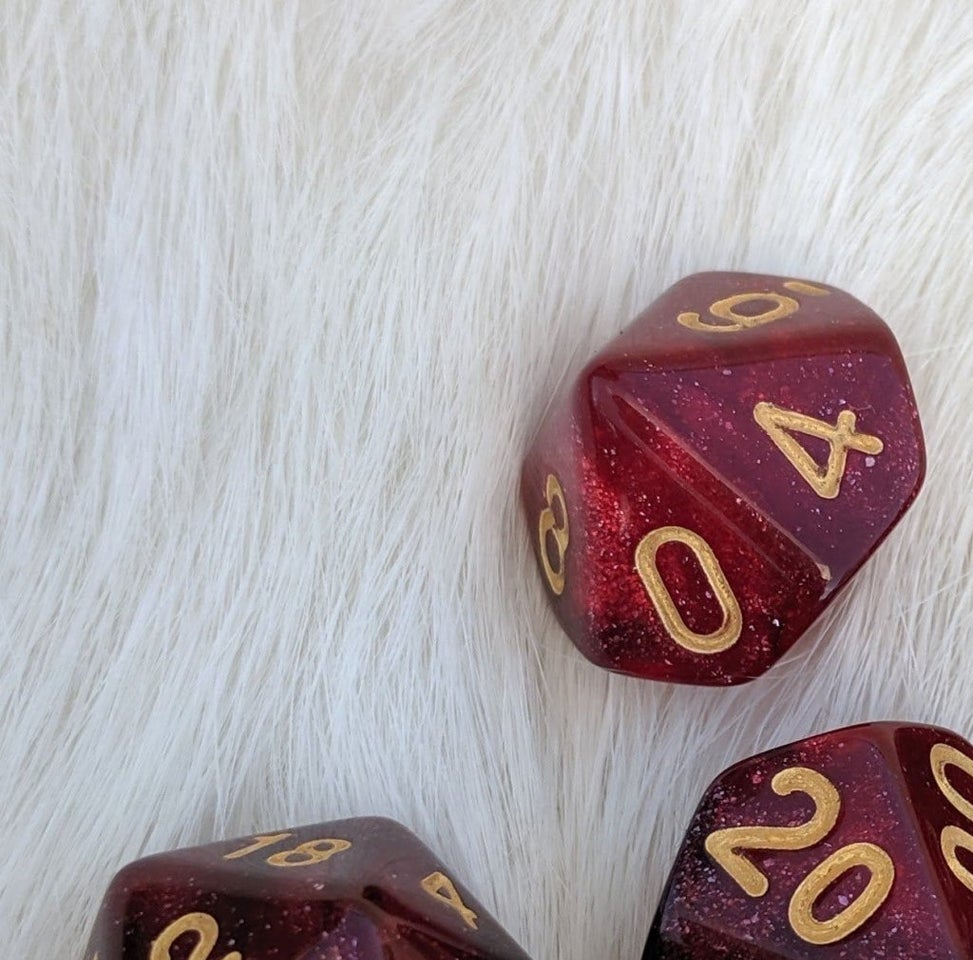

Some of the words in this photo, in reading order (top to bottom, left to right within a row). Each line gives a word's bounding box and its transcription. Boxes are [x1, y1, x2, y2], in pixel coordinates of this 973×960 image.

[753, 401, 884, 500] 4
[538, 474, 570, 596] 8
[634, 525, 743, 654] 0
[224, 833, 352, 867] 18
[421, 871, 479, 930] 4
[705, 767, 895, 945] 20
